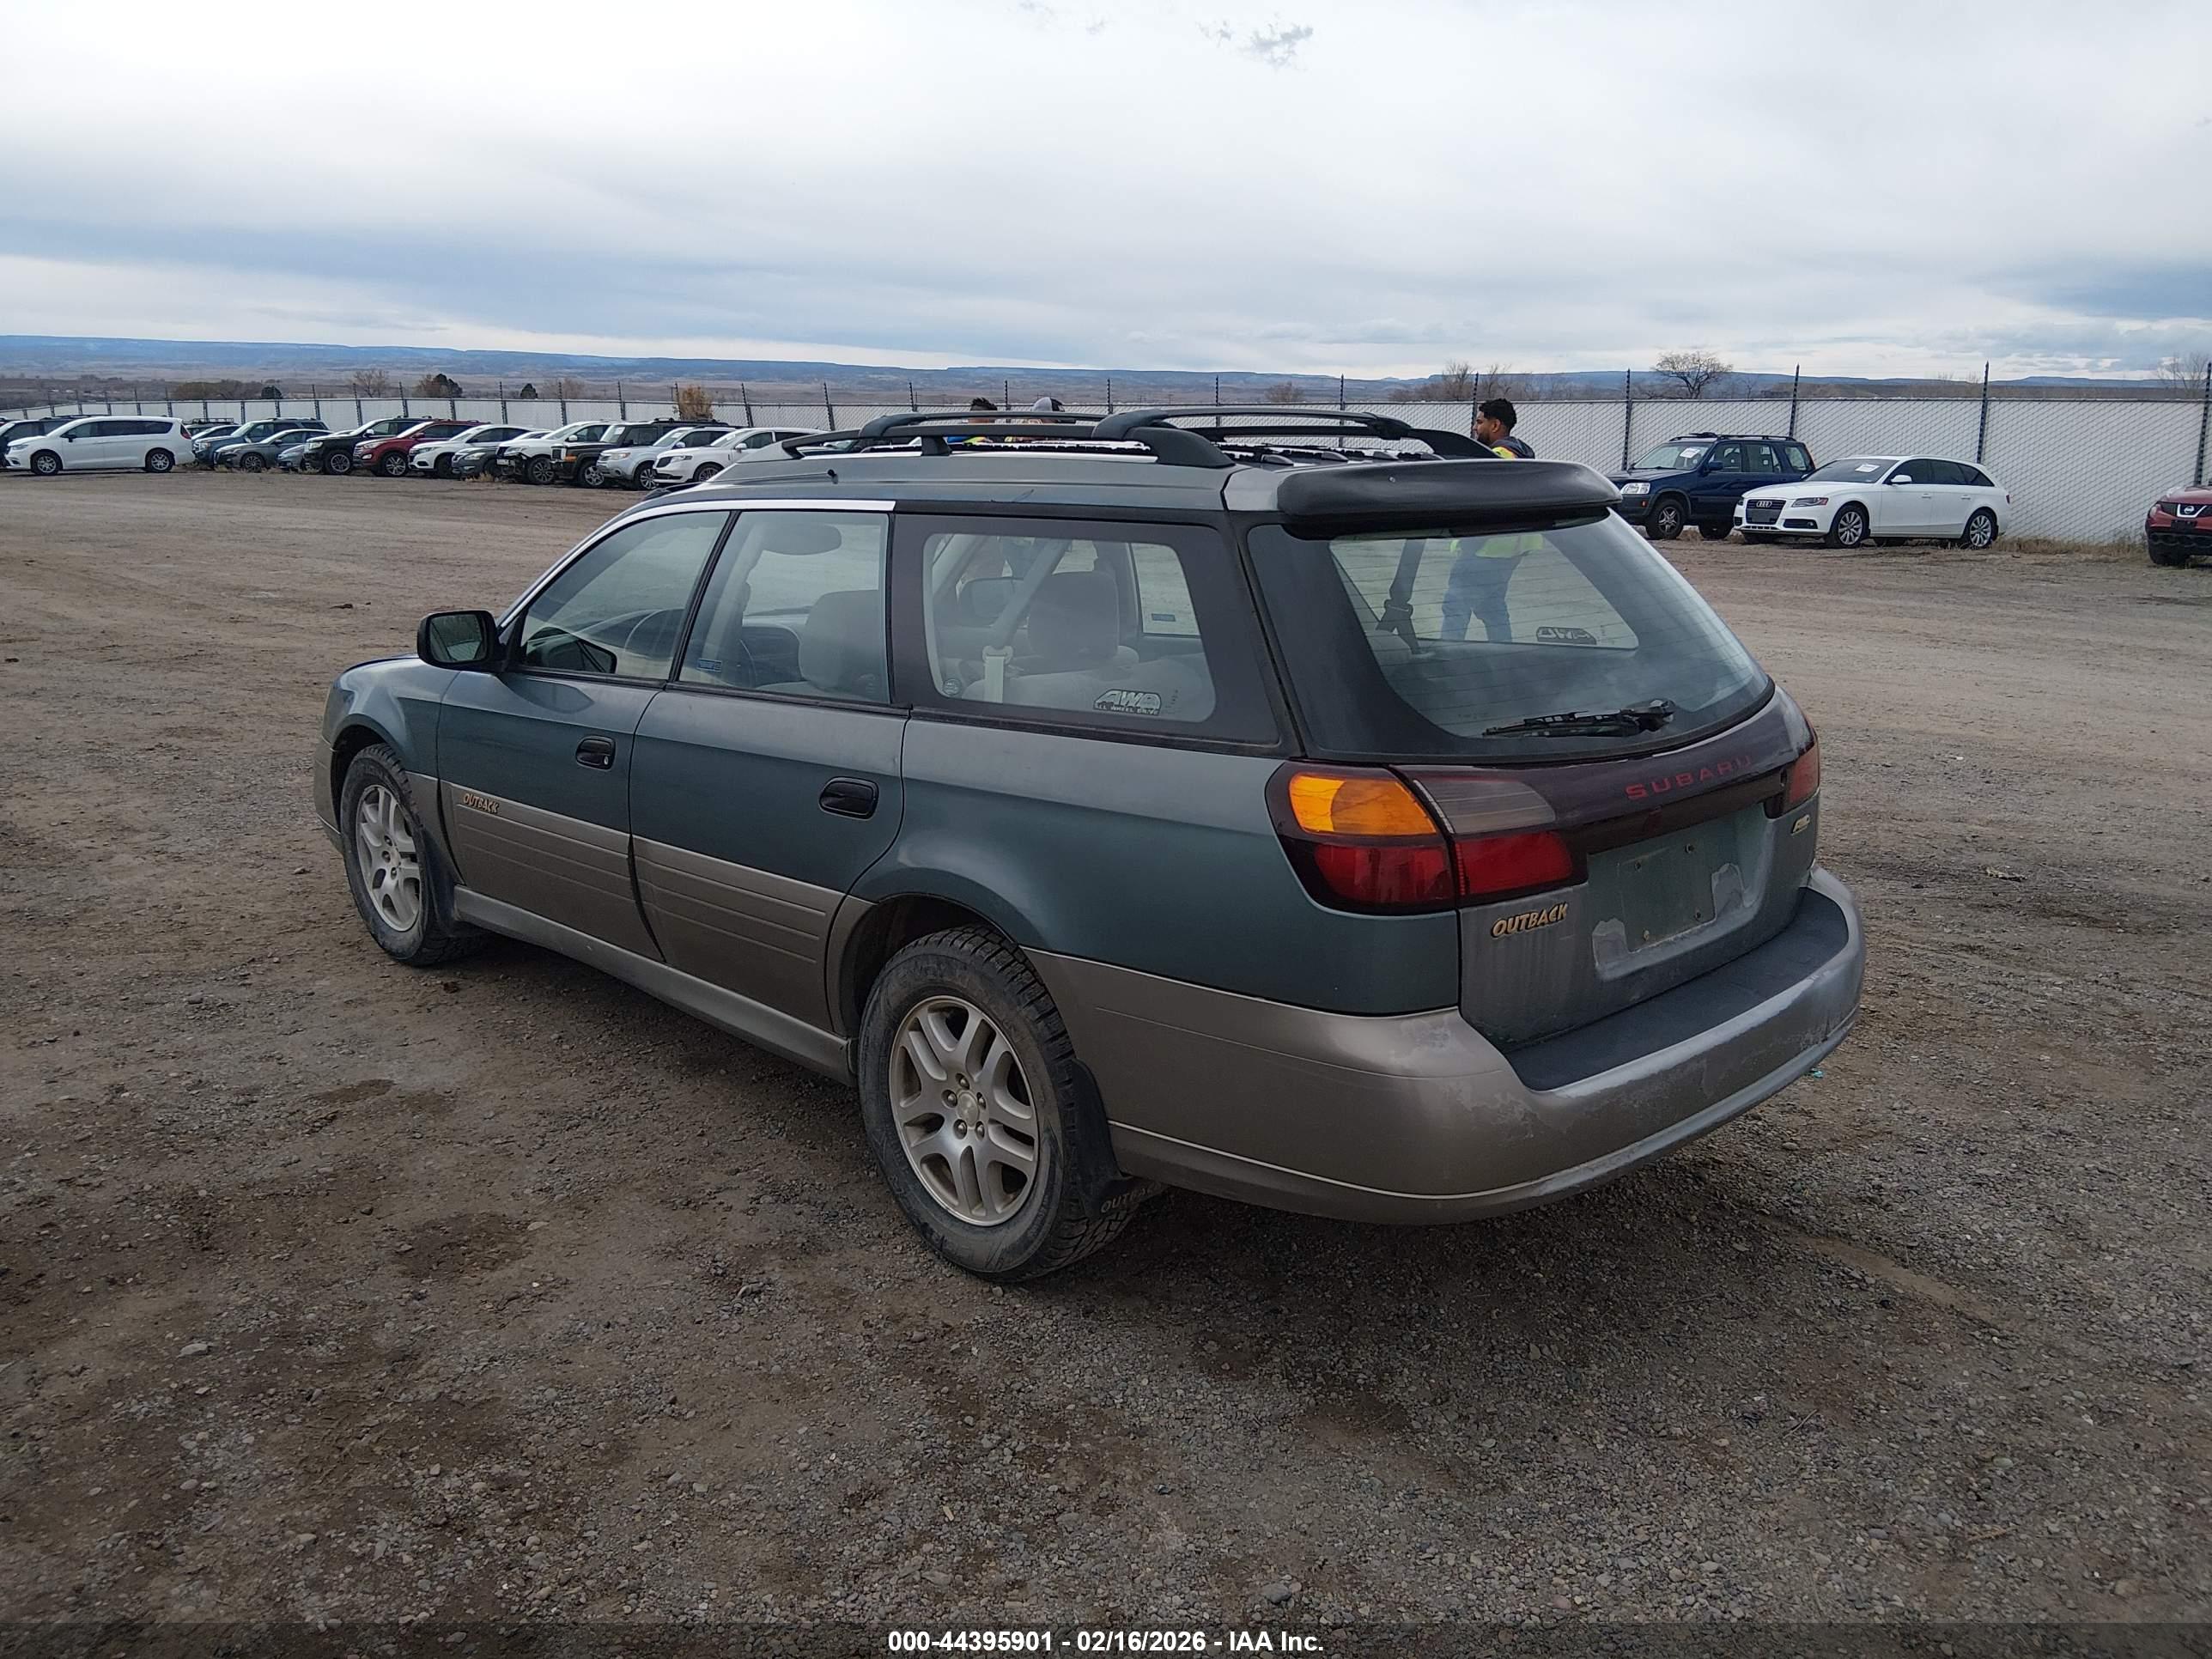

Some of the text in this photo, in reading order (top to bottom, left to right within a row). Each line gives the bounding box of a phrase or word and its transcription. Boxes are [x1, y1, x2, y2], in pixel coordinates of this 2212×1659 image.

[1095, 690, 1161, 711] AWD
[1625, 756, 1752, 799] SUBARU
[463, 793, 499, 814] OUTBACK
[1492, 902, 1568, 938] OUTBACK
